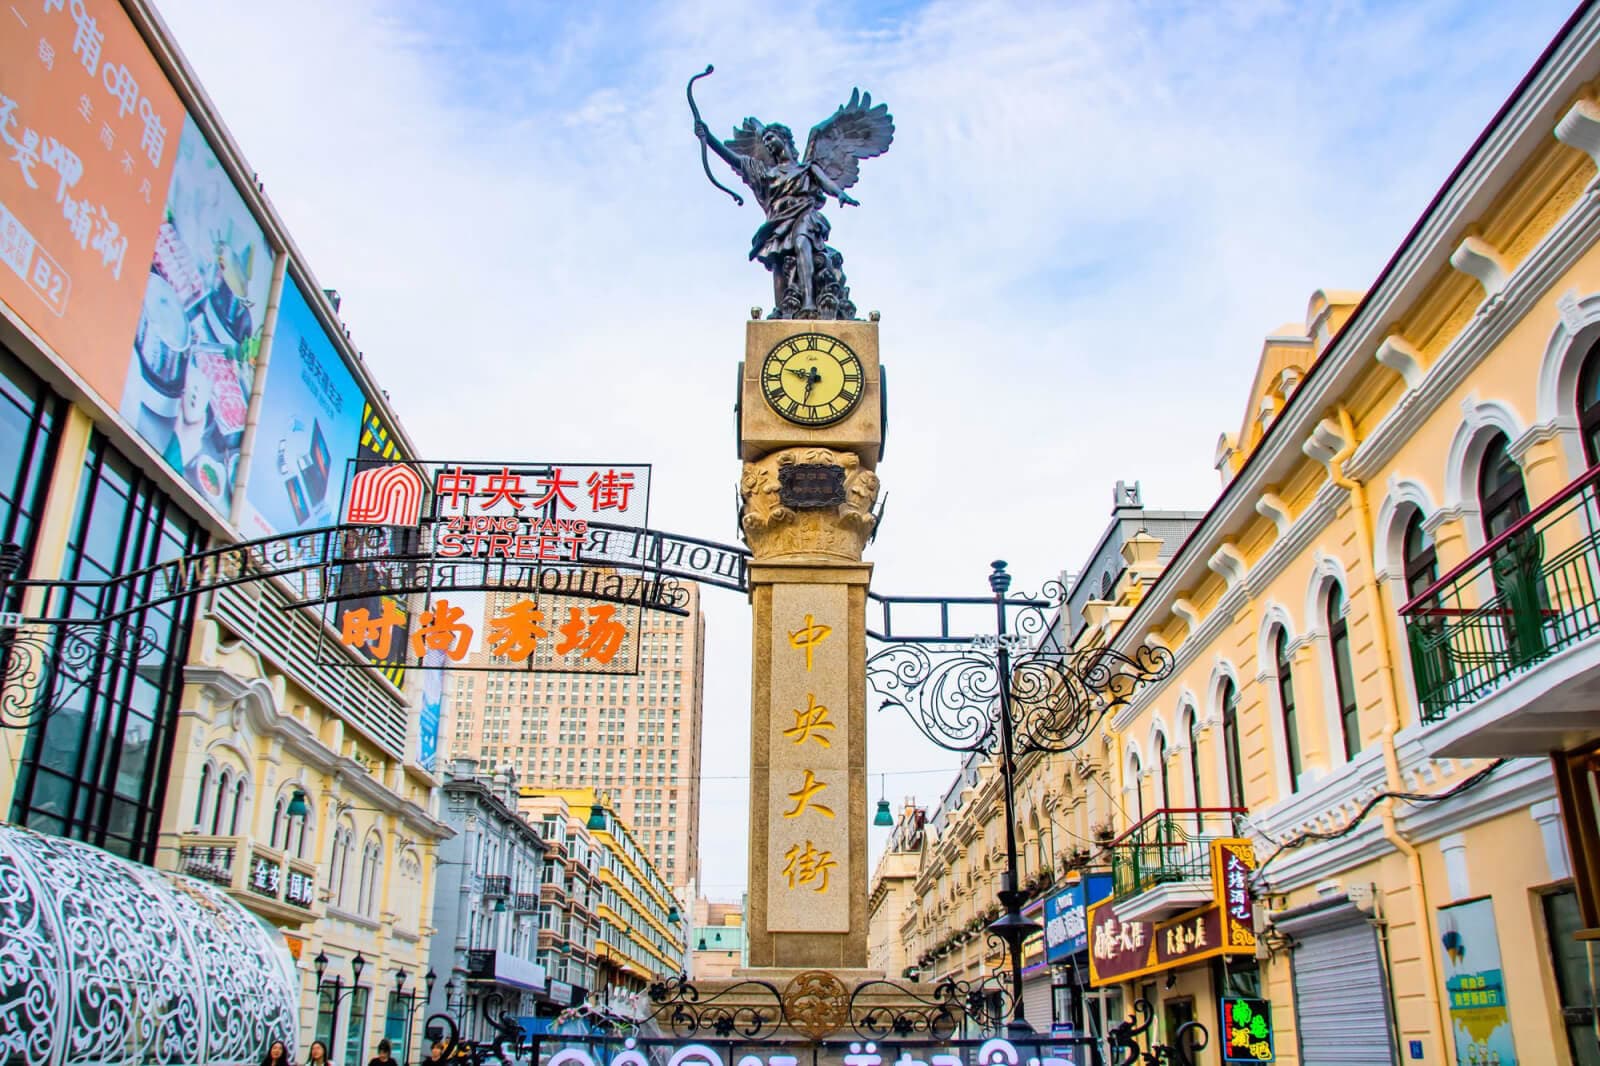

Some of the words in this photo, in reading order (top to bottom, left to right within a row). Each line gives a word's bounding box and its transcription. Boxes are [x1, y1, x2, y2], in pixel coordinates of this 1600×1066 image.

[42, 0, 168, 168] 哺呷哺
[33, 255, 64, 304] B2
[436, 466, 636, 513] 中央大街
[438, 534, 588, 561] STREET
[446, 515, 519, 532] ZHONG
[528, 517, 588, 534] YANG
[342, 599, 628, 664] 时尚秀场
[971, 633, 1038, 649] AMSTEL
[783, 614, 838, 894] 中央大街
